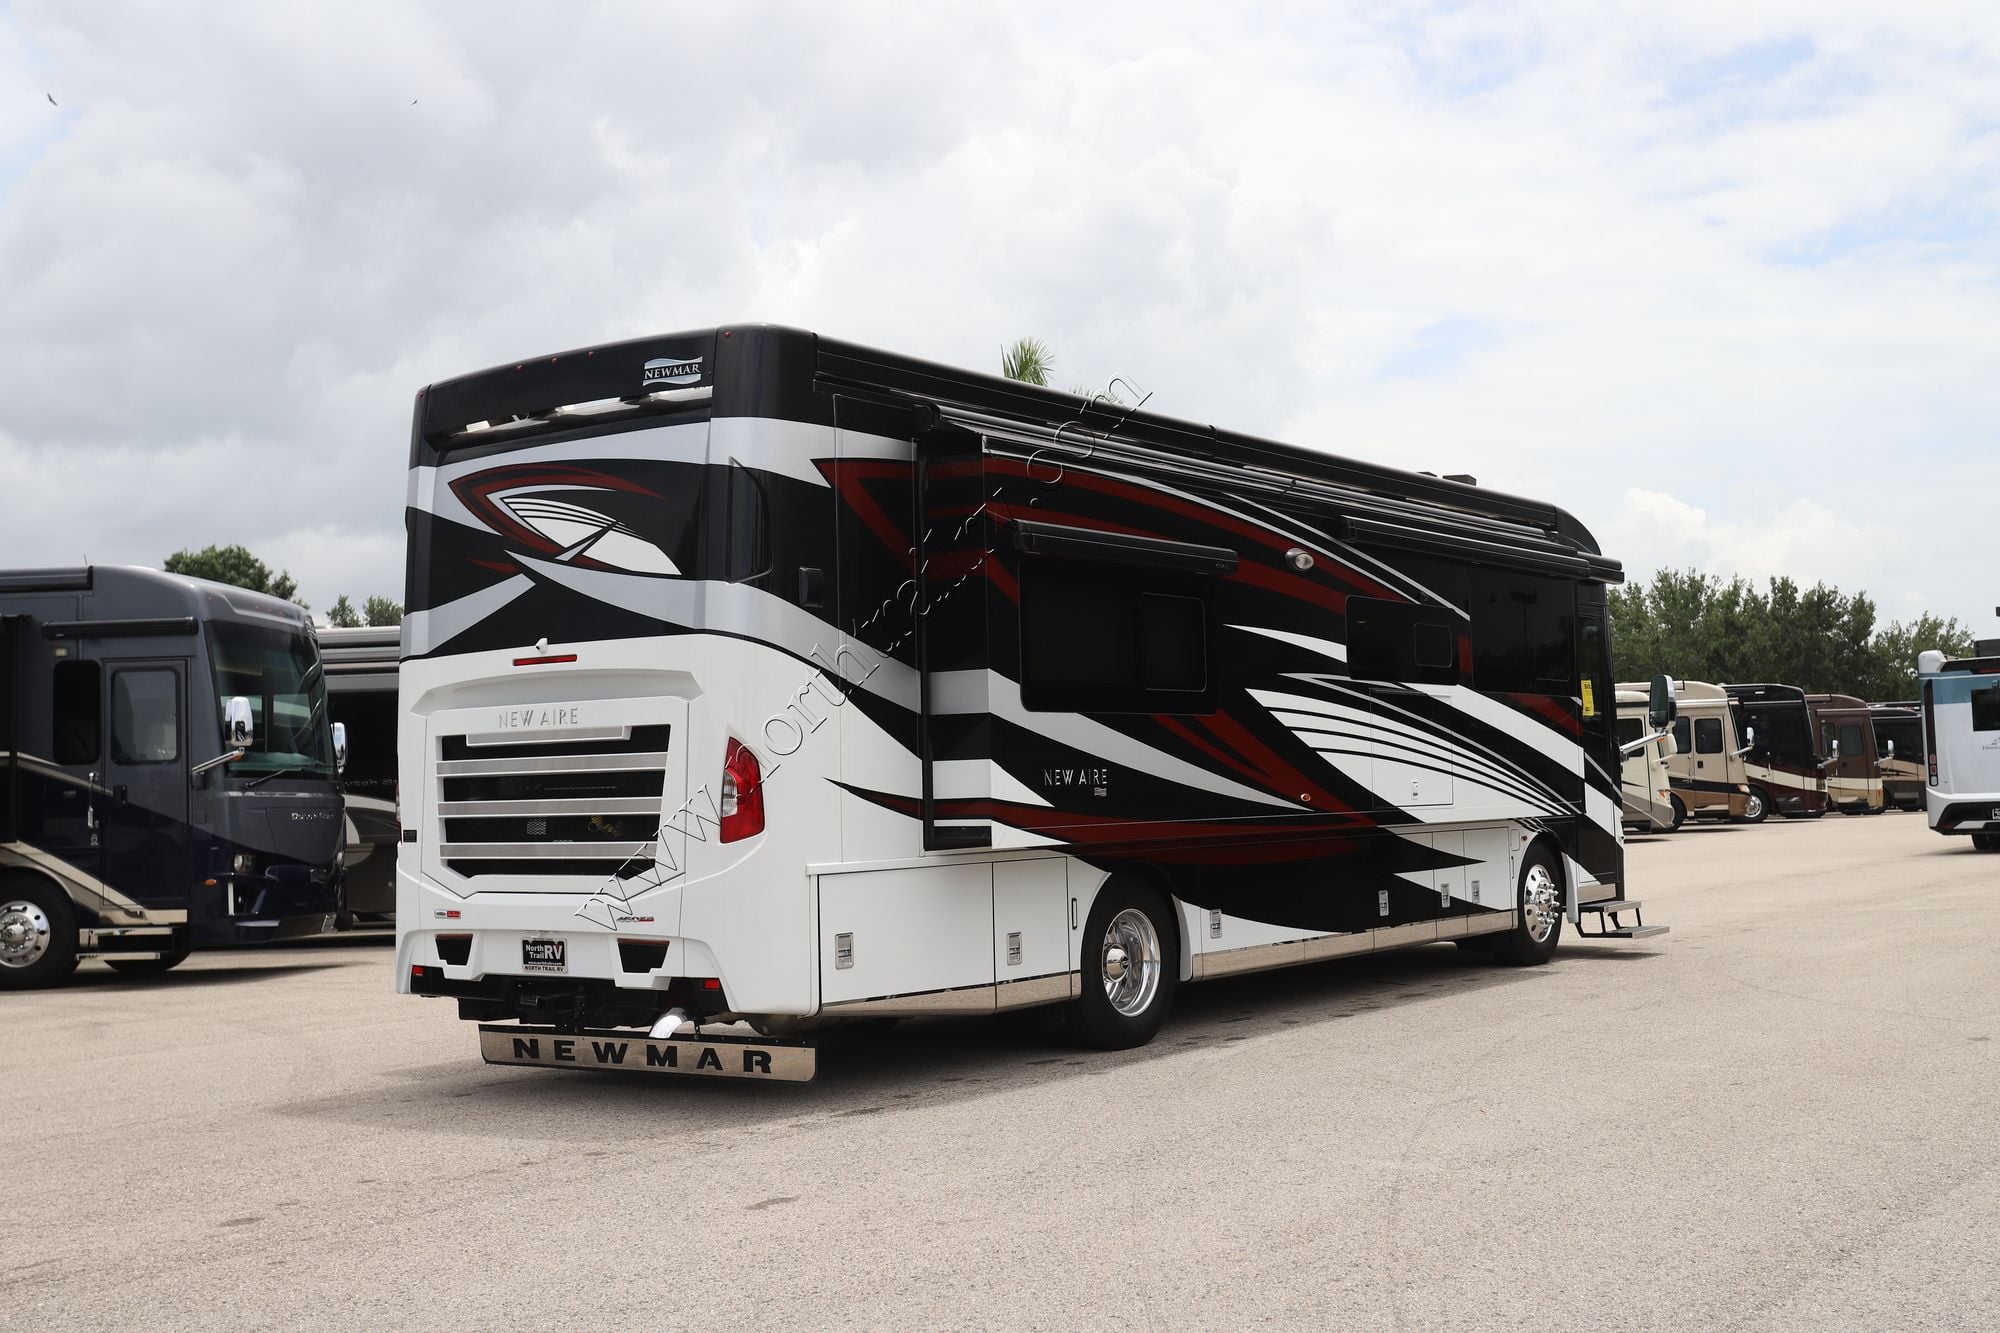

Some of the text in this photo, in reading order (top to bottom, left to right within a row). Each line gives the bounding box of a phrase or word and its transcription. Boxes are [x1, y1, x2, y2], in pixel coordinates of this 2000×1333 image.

[644, 364, 701, 380] NEWMAR
[498, 707, 578, 729] NEW AIRE
[1044, 768, 1108, 786] NEW AIRE
[529, 951, 544, 959] Trail
[544, 945, 562, 959] RV
[512, 1038, 772, 1074] NEWMAR
